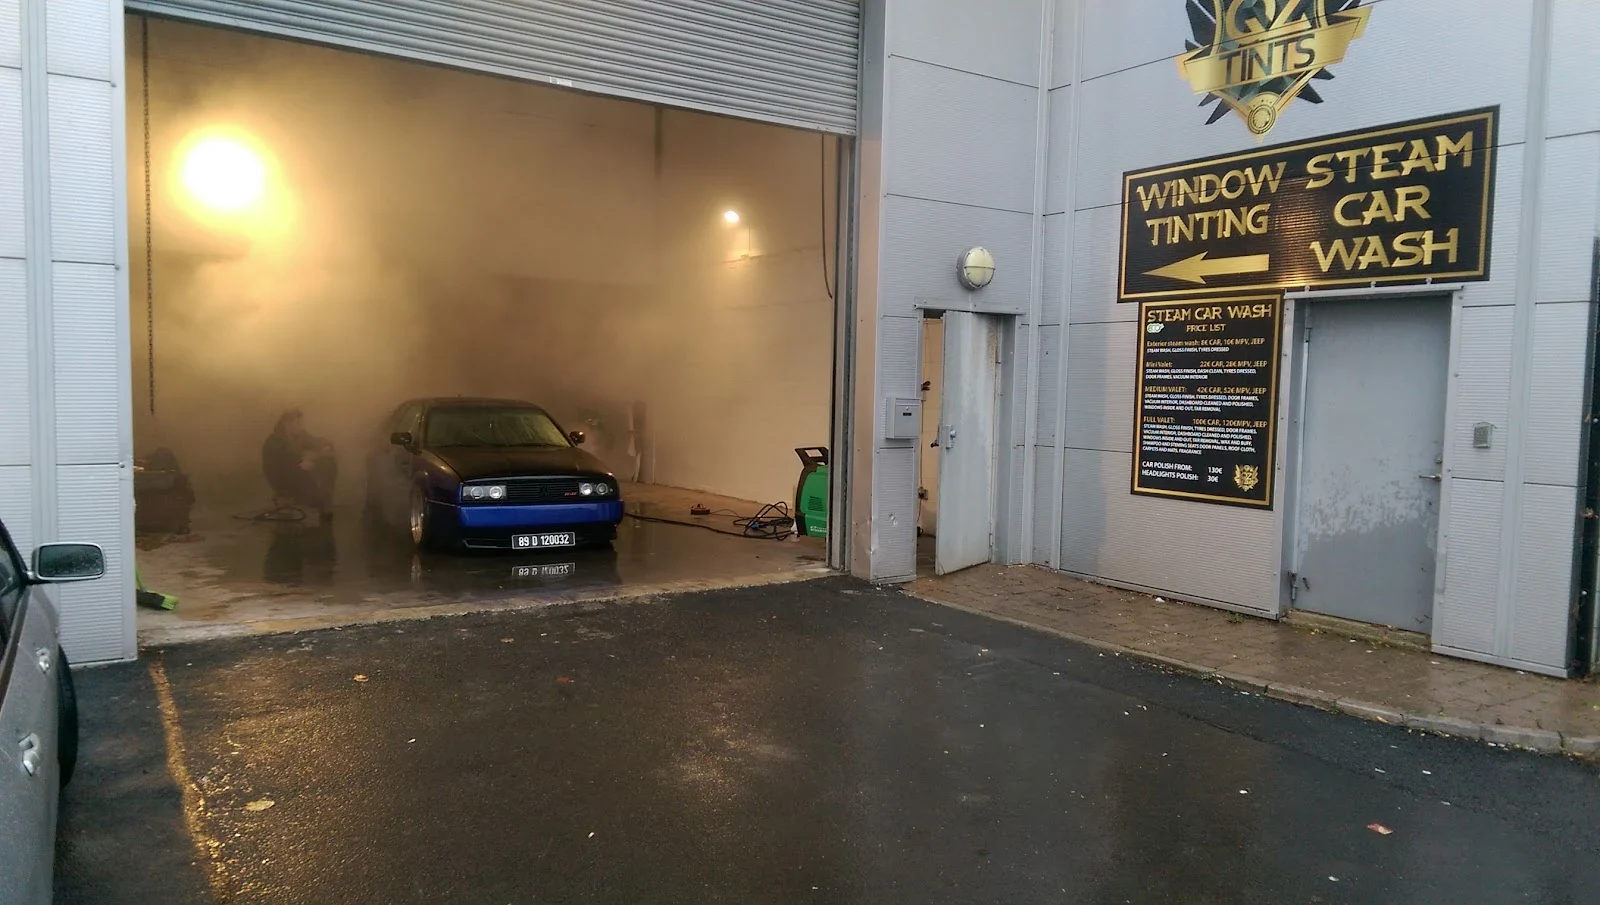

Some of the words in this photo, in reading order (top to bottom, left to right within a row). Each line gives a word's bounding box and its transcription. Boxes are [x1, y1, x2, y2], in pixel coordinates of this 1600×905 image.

[1219, 34, 1315, 84] TINTS
[1306, 131, 1474, 190] STEAM
[1136, 162, 1286, 212] WINDOW
[1334, 185, 1431, 226] CAR
[1146, 204, 1271, 246] TINTING
[1310, 228, 1458, 272] WASH
[1148, 308, 1191, 322] STEAM
[1195, 306, 1222, 320] CAR
[1228, 304, 1272, 318] WASH
[1186, 324, 1207, 332] PRICE
[1210, 324, 1226, 332] LIST
[1142, 470, 1175, 479] HEADLIGHTS
[1174, 463, 1192, 471] FROM:
[518, 536, 529, 546] 89
[532, 536, 537, 546] D
[541, 534, 569, 546] 120032
